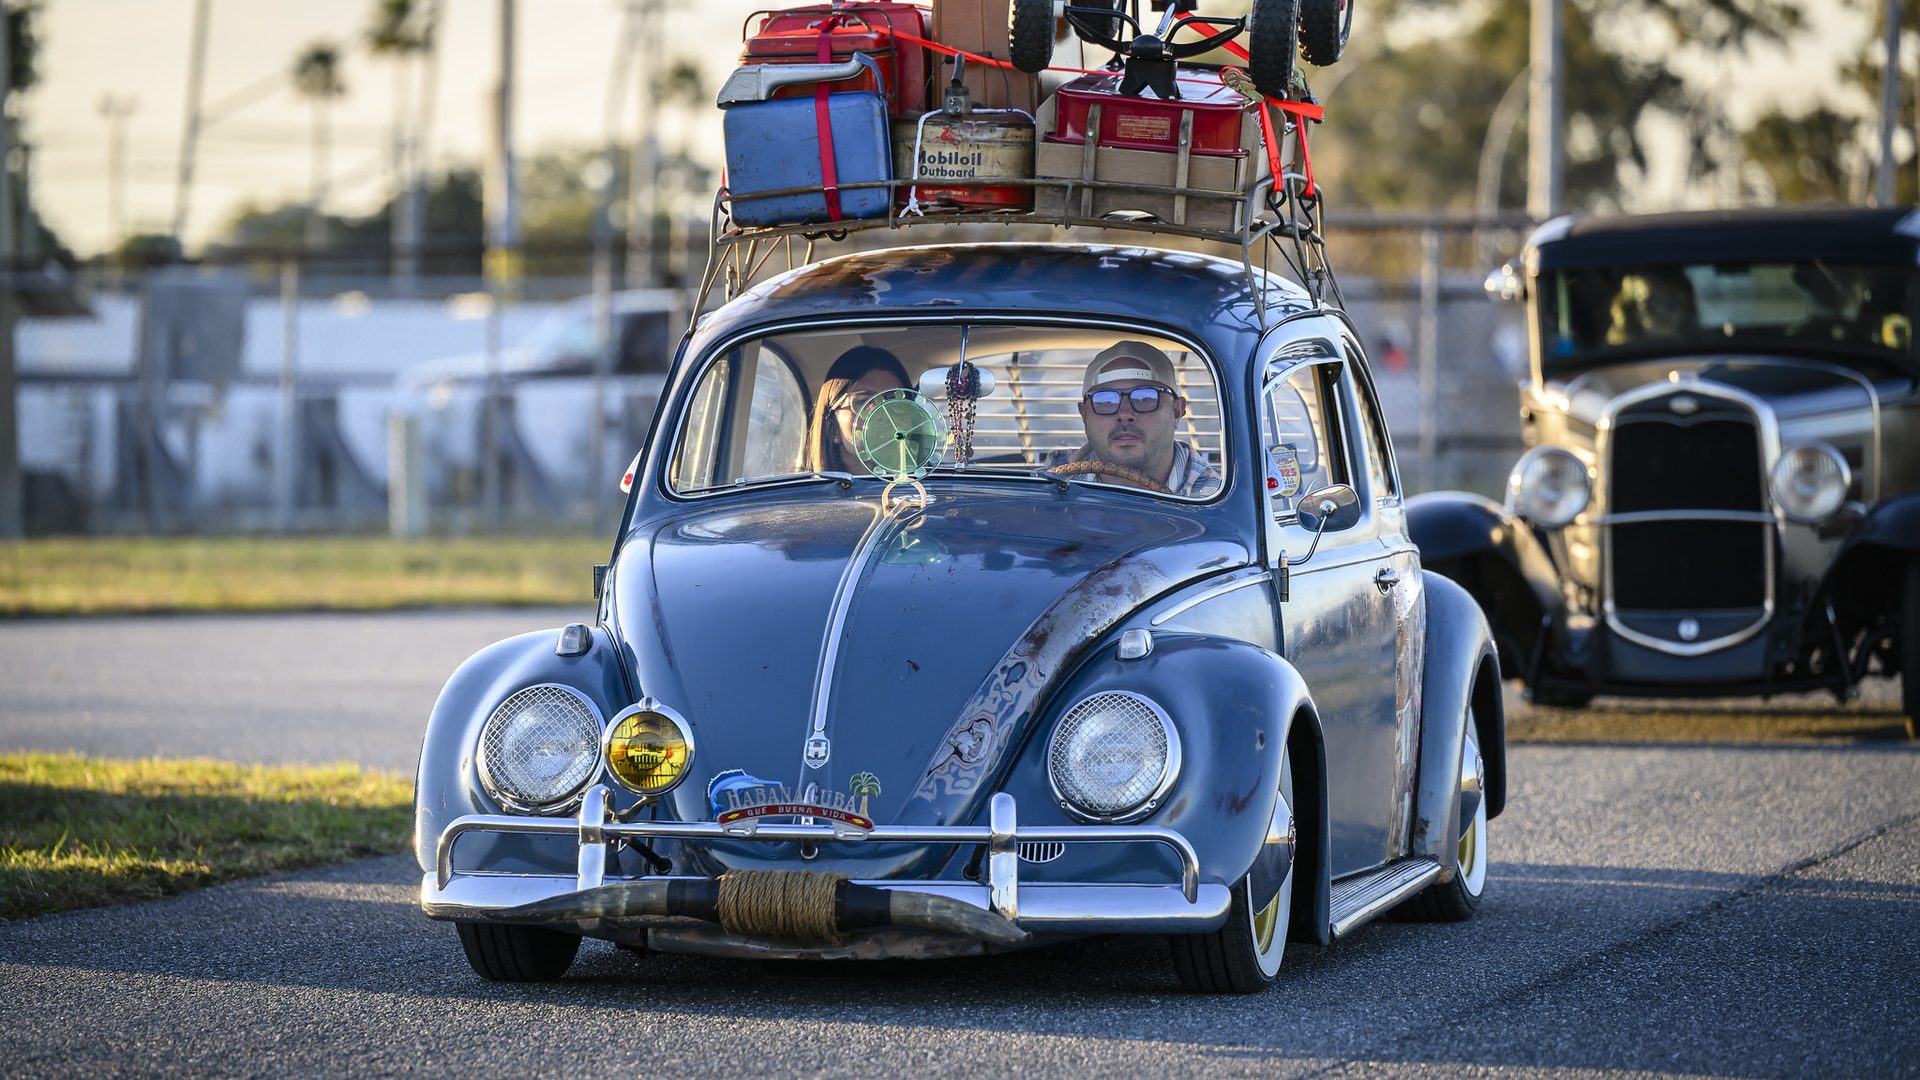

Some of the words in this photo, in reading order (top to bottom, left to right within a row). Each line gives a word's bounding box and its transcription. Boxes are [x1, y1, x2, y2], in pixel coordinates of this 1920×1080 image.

[919, 165, 975, 178] Outboard
[726, 785, 804, 811] HABANA
[747, 807, 768, 817] QUE
[778, 806, 813, 814] BUENA
[822, 809, 846, 820] VIDA
